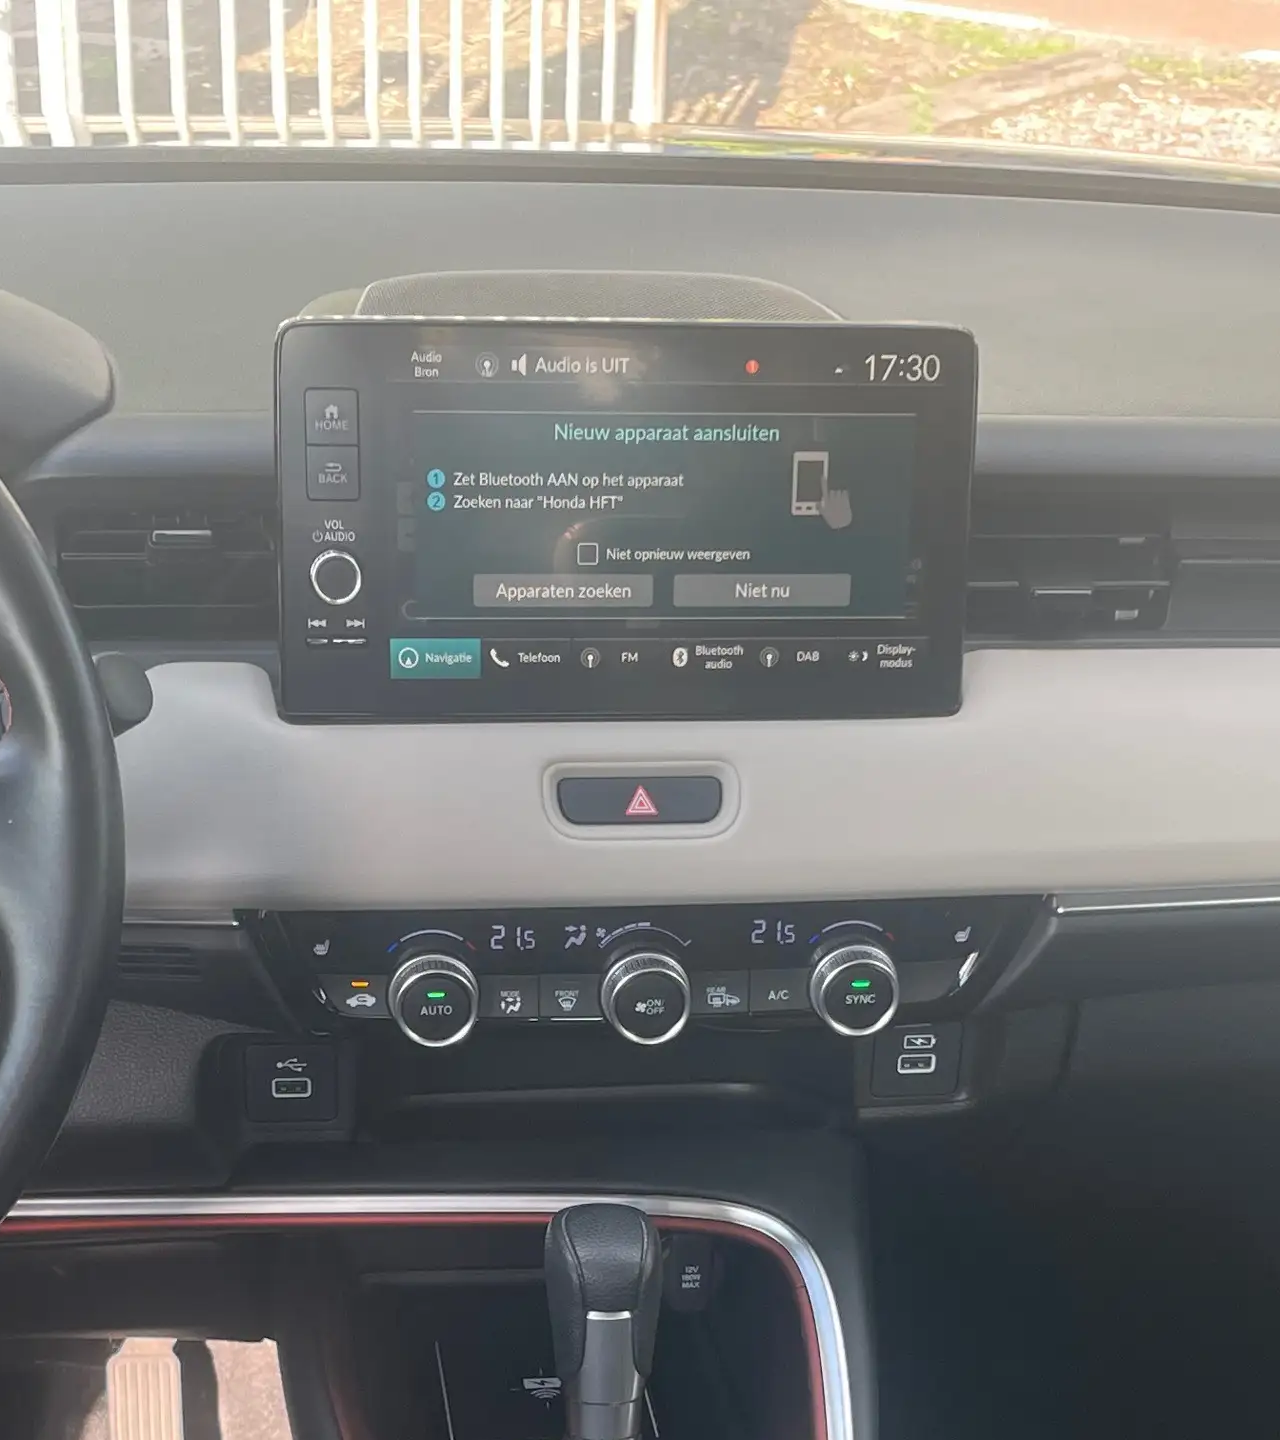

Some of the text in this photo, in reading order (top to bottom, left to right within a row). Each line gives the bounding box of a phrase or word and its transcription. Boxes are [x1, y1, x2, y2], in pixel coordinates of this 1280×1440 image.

[411, 351, 442, 363] Audio
[535, 356, 630, 374] Audio is UIT
[864, 354, 941, 382] 17:30
[414, 366, 439, 378] Bron
[315, 420, 349, 431] HOME
[554, 423, 780, 444] Nieuw apparaat aansluiten
[318, 474, 348, 484] BACK
[454, 472, 684, 490] Zet Bluetooth AAN op het apparaat
[454, 495, 624, 510] Zoeken naar "Honda HFT"
[324, 520, 344, 530] VOL
[324, 532, 356, 542] AUDIO
[606, 549, 751, 562] Niet opnieuw weergeven
[496, 583, 631, 601] Apparaten zoeken
[735, 583, 790, 598] Niet nu
[695, 645, 744, 657] Bluetooth
[877, 643, 916, 656] Display-
[425, 653, 472, 666] Navigatie
[518, 652, 561, 664] Telefoon
[621, 652, 639, 663] FM
[796, 651, 820, 662] DAB
[879, 657, 913, 668] modus
[705, 659, 733, 669] audio
[490, 924, 536, 951] 21.5
[751, 919, 795, 945] 21.5
[500, 990, 520, 998] MODE
[554, 990, 579, 998] FRONT
[768, 990, 789, 1000] A/C
[845, 994, 876, 1005] SYNC
[420, 1005, 453, 1016] AUTO
[646, 1006, 665, 1015] OFF
